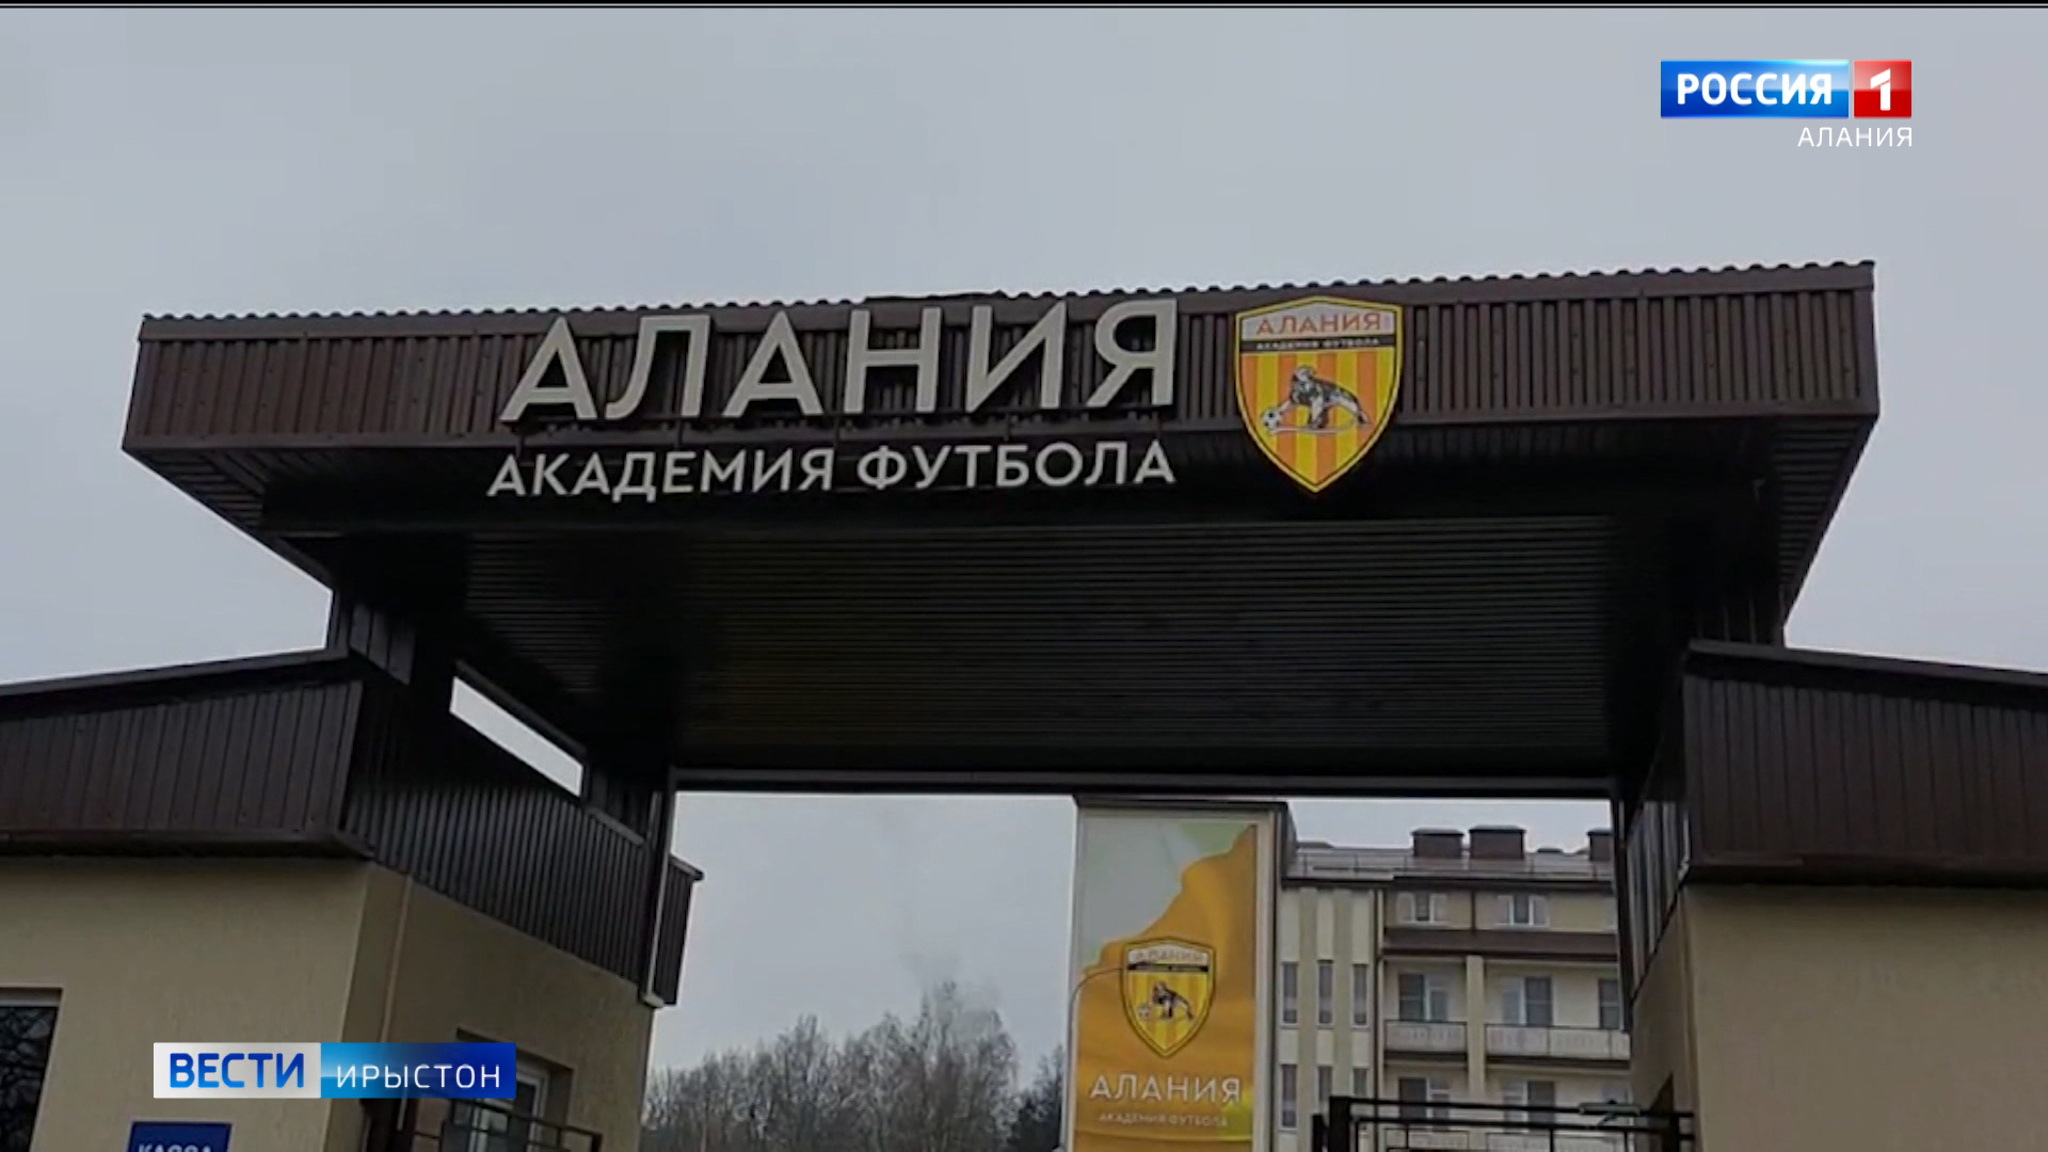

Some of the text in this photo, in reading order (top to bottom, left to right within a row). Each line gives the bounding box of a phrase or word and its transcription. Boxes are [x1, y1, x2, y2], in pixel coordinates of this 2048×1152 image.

[1256, 312, 1381, 335] АЛАНИЯ
[500, 299, 1177, 420] АЛАНИЯ
[487, 440, 1178, 502] АКАДЕМИЯ ФУТБОЛА
[1090, 1073, 1240, 1104] АЛАНИЯ
